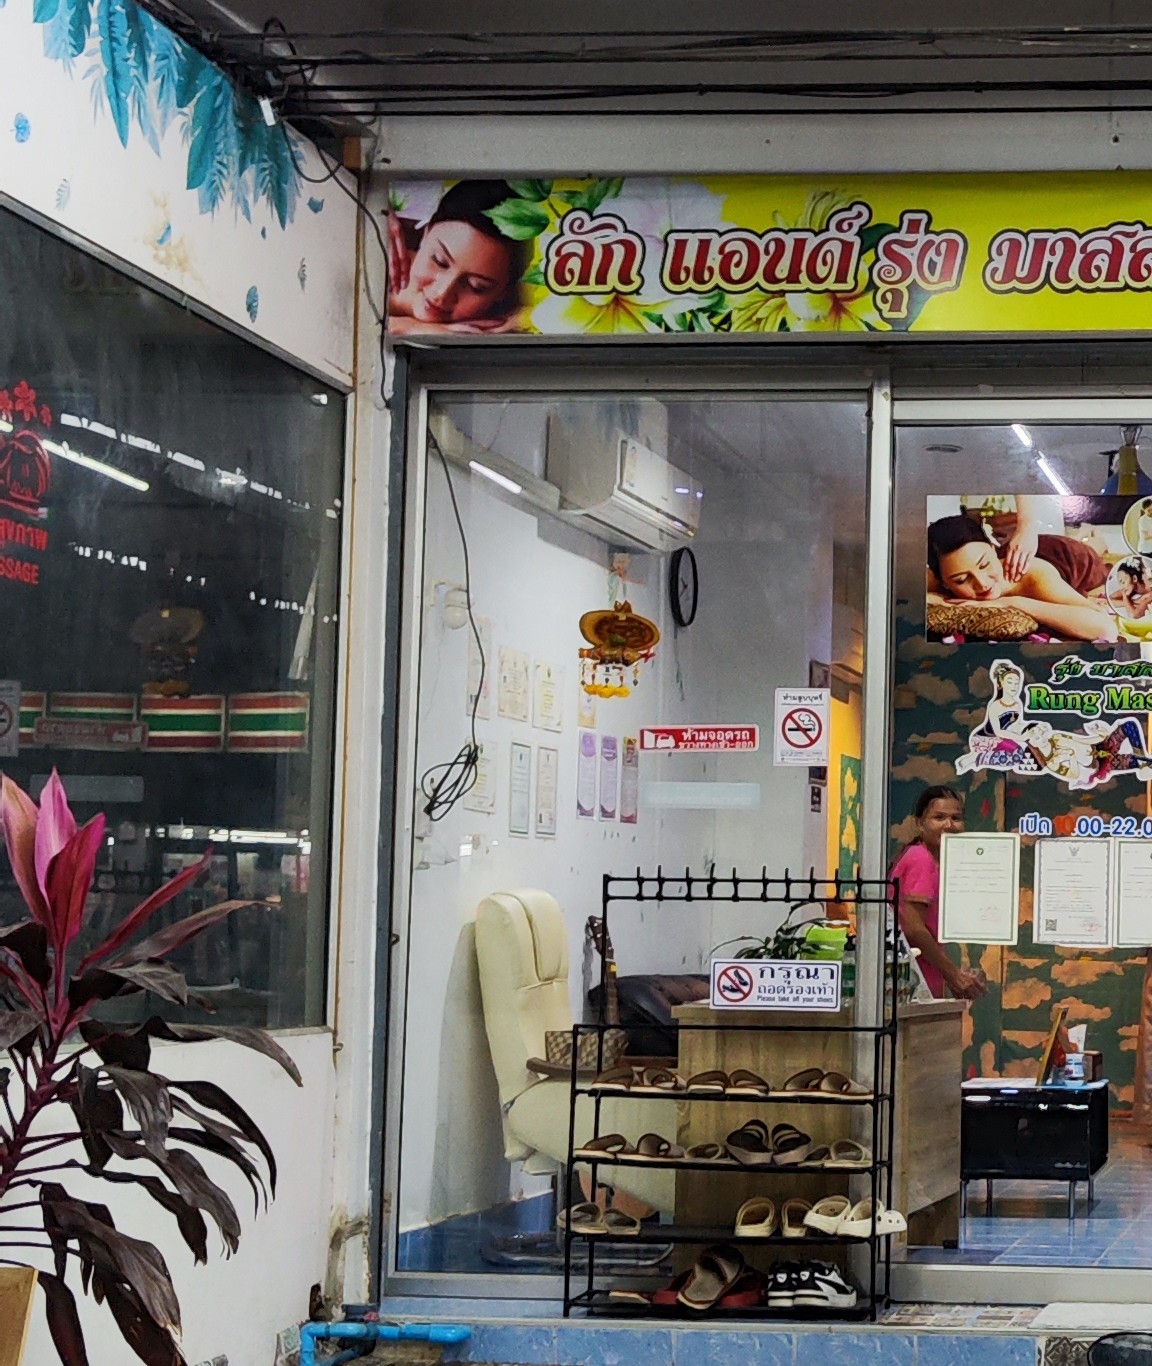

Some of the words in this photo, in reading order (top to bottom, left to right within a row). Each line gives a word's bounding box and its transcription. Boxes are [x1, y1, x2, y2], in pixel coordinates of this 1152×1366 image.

[666, 204, 868, 290] แอนด์
[876, 213, 964, 317] รุ่ง
[1028, 685, 1100, 716] Rung
[1019, 813, 1051, 835] เปิด
[759, 966, 835, 985] กรุณา
